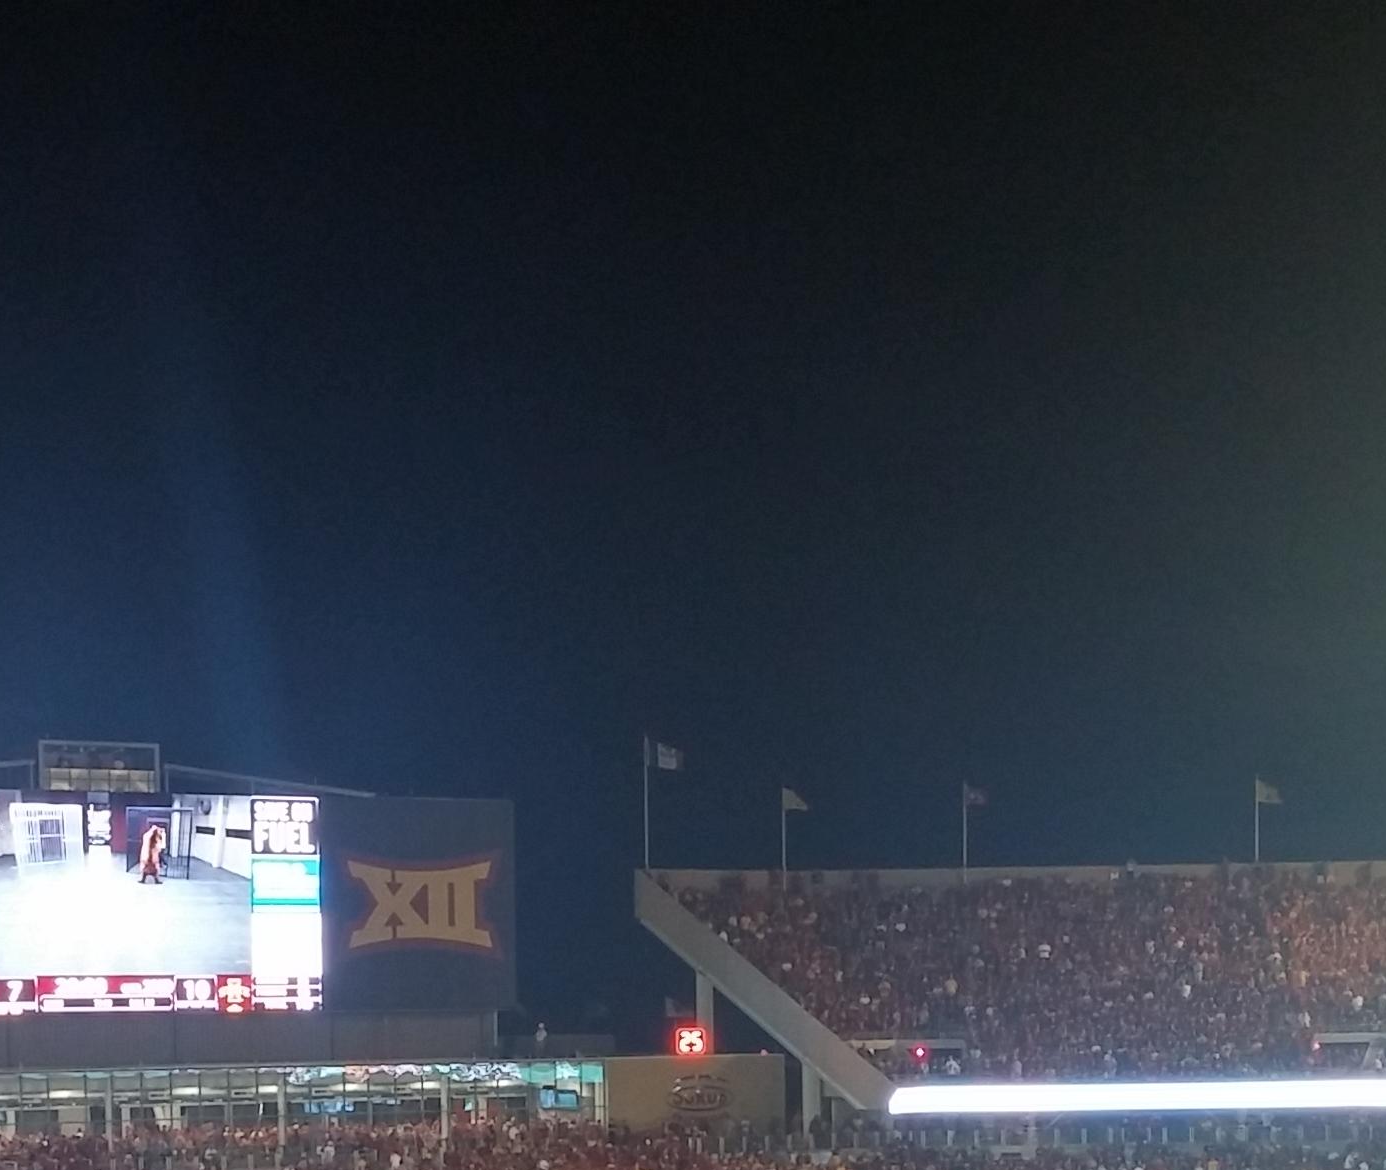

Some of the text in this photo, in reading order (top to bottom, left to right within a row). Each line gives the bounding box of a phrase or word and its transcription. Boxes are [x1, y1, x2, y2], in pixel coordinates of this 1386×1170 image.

[254, 821, 316, 852] FUEL
[348, 860, 493, 949] XII
[6, 980, 24, 1002] 7
[183, 980, 211, 1001] 10
[679, 1030, 704, 1052] 25
